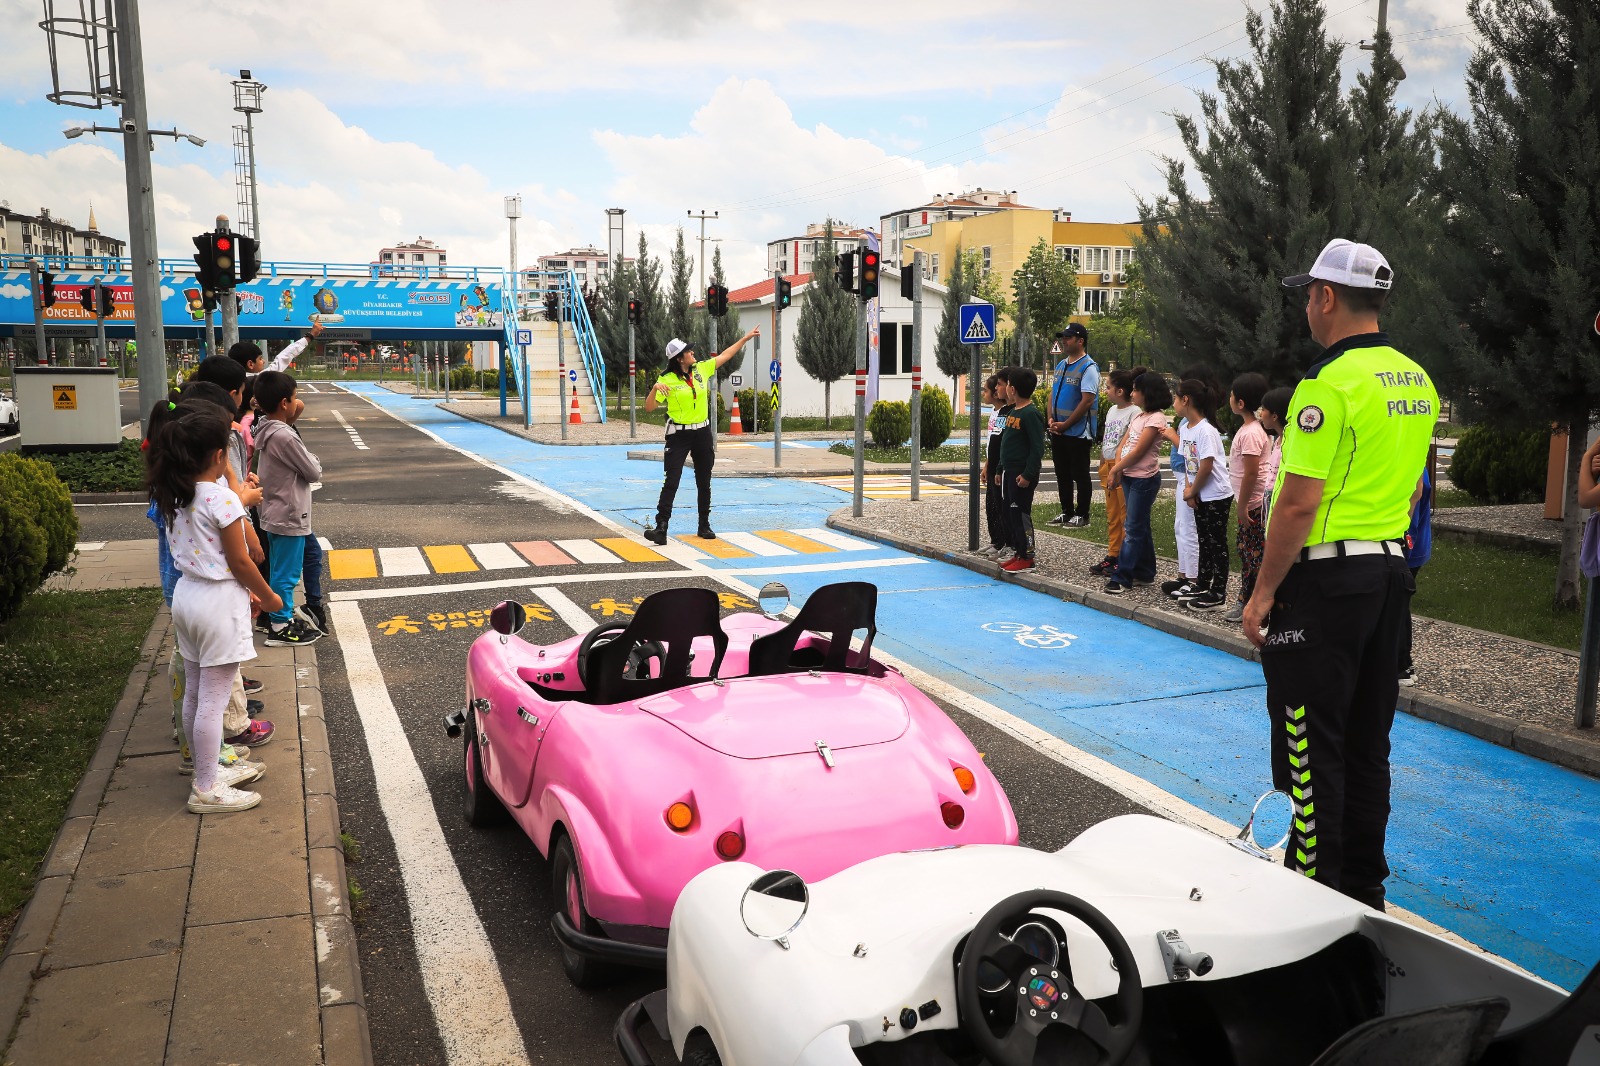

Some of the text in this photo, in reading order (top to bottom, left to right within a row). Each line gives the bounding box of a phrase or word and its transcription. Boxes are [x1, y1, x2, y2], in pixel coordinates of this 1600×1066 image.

[46, 306, 91, 318] ÖNCELİK
[343, 309, 384, 317] BÜYÜKŞEHİR
[1375, 371, 1428, 389] TRAFİK
[1387, 399, 1431, 417] POLİSİ
[430, 618, 491, 631] yay
